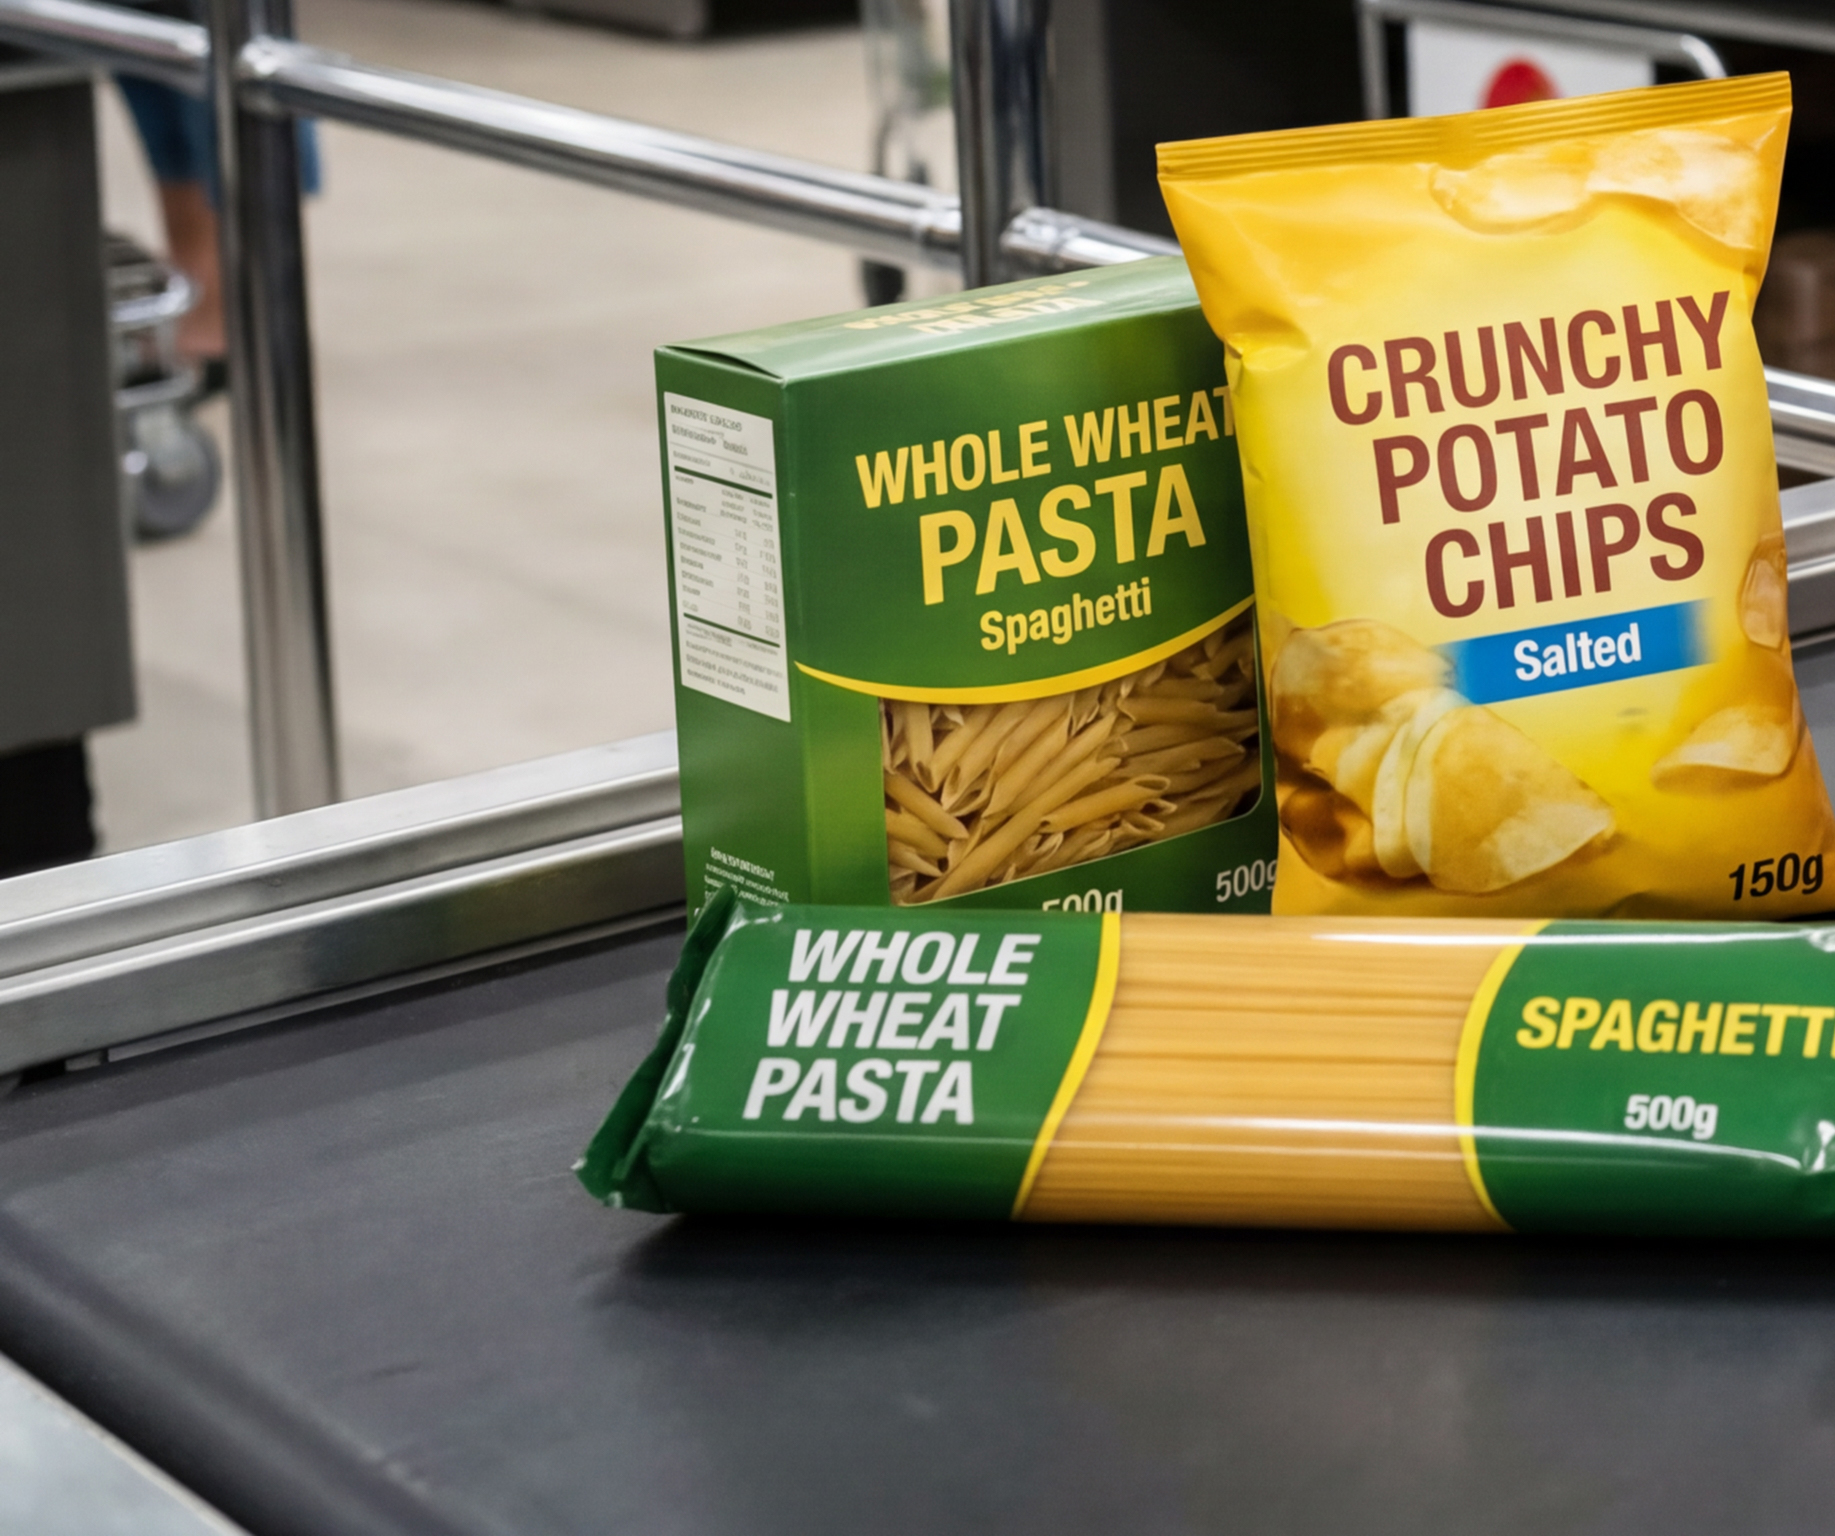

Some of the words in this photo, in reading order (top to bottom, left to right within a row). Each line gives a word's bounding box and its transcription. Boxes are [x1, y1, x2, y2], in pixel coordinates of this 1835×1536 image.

[1326, 290, 1730, 426] CRUNCHY
[856, 420, 1051, 508] WHOLE
[1064, 385, 1235, 467] WHEAT
[1372, 388, 1725, 525] POTATO
[919, 464, 1206, 606] PASTA
[1424, 491, 1706, 619] CHIPS
[979, 577, 1152, 655] Spaghetti
[1513, 622, 1642, 682] Salted
[1728, 851, 1826, 901] 150g
[788, 929, 1042, 985] WHOLE
[767, 989, 1022, 1051] WHEAT
[742, 1057, 974, 1125] PASTA
[1624, 1094, 1718, 1141] 500g
